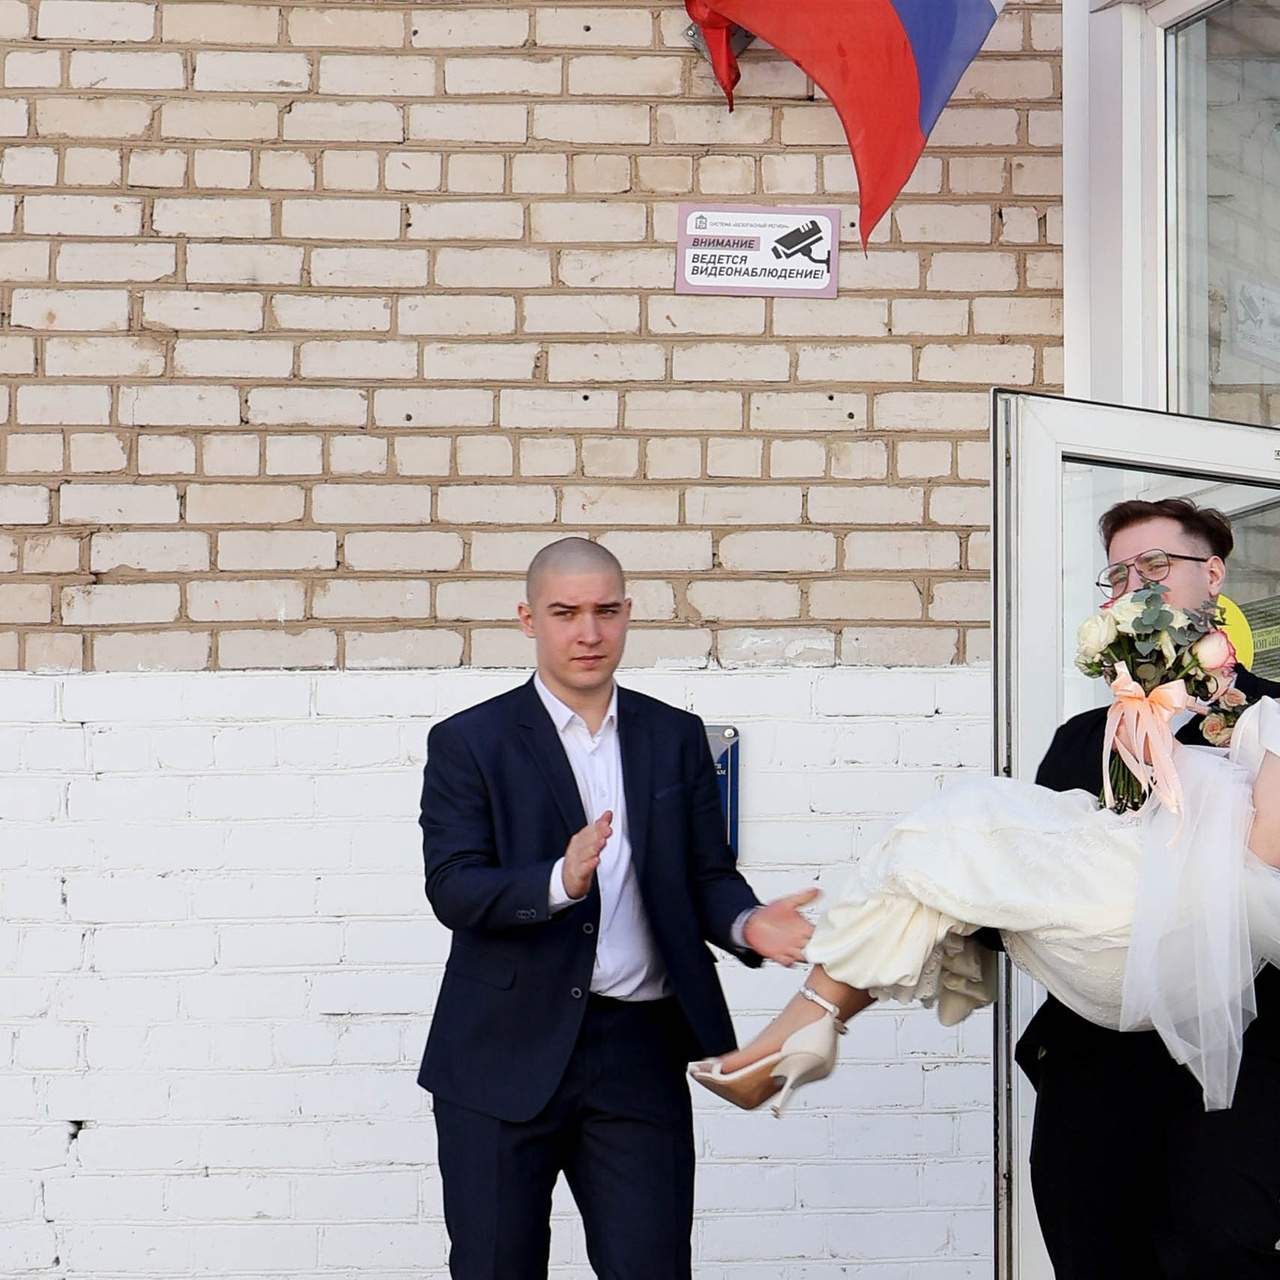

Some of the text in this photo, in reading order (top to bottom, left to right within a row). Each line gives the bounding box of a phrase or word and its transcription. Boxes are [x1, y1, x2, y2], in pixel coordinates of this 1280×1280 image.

[692, 237, 756, 249] ВНИМАНИЕ
[691, 253, 748, 265] ВЕДЕТСЯ
[691, 265, 825, 280] ВИДЕОНАБЛЮДЕНИЕ!
